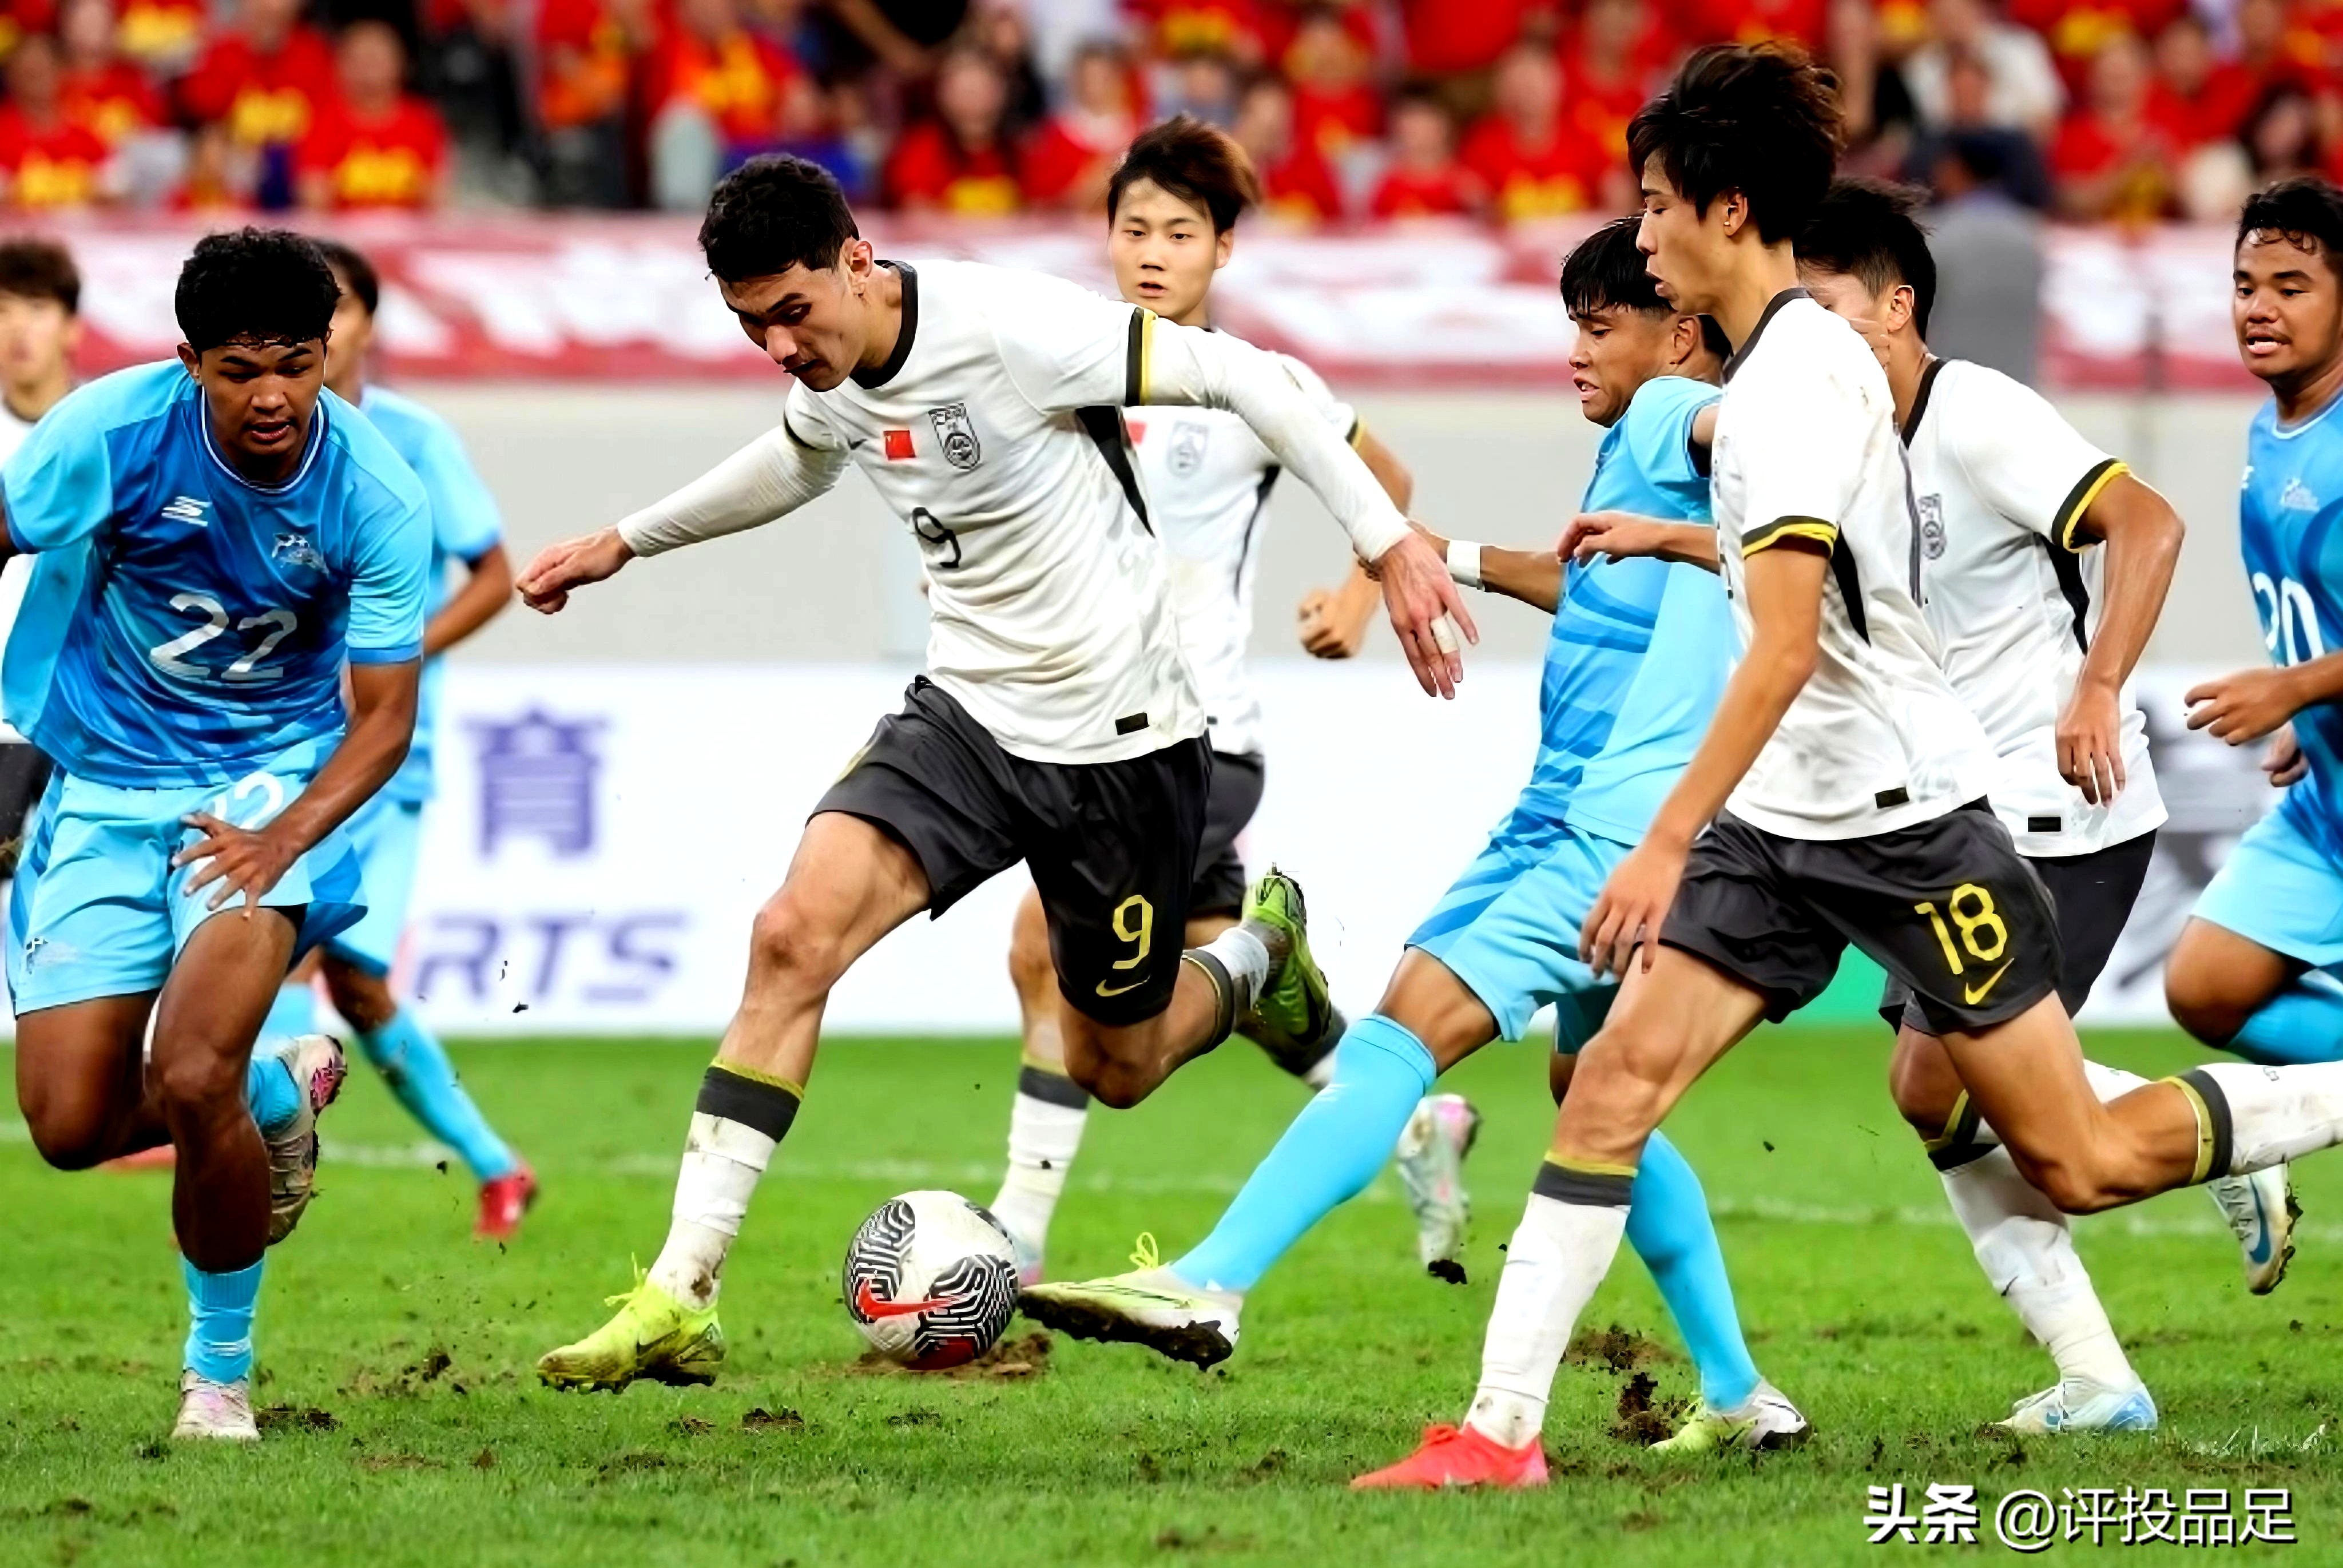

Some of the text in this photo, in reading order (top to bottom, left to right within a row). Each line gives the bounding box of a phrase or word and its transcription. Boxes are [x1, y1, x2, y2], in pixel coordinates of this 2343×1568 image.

[912, 507, 961, 568] 9
[149, 593, 297, 681] 22
[2252, 572, 2325, 668] 20
[400, 912, 685, 998] RTS
[1112, 894, 1153, 969] 9
[1914, 883, 2007, 975] 18
